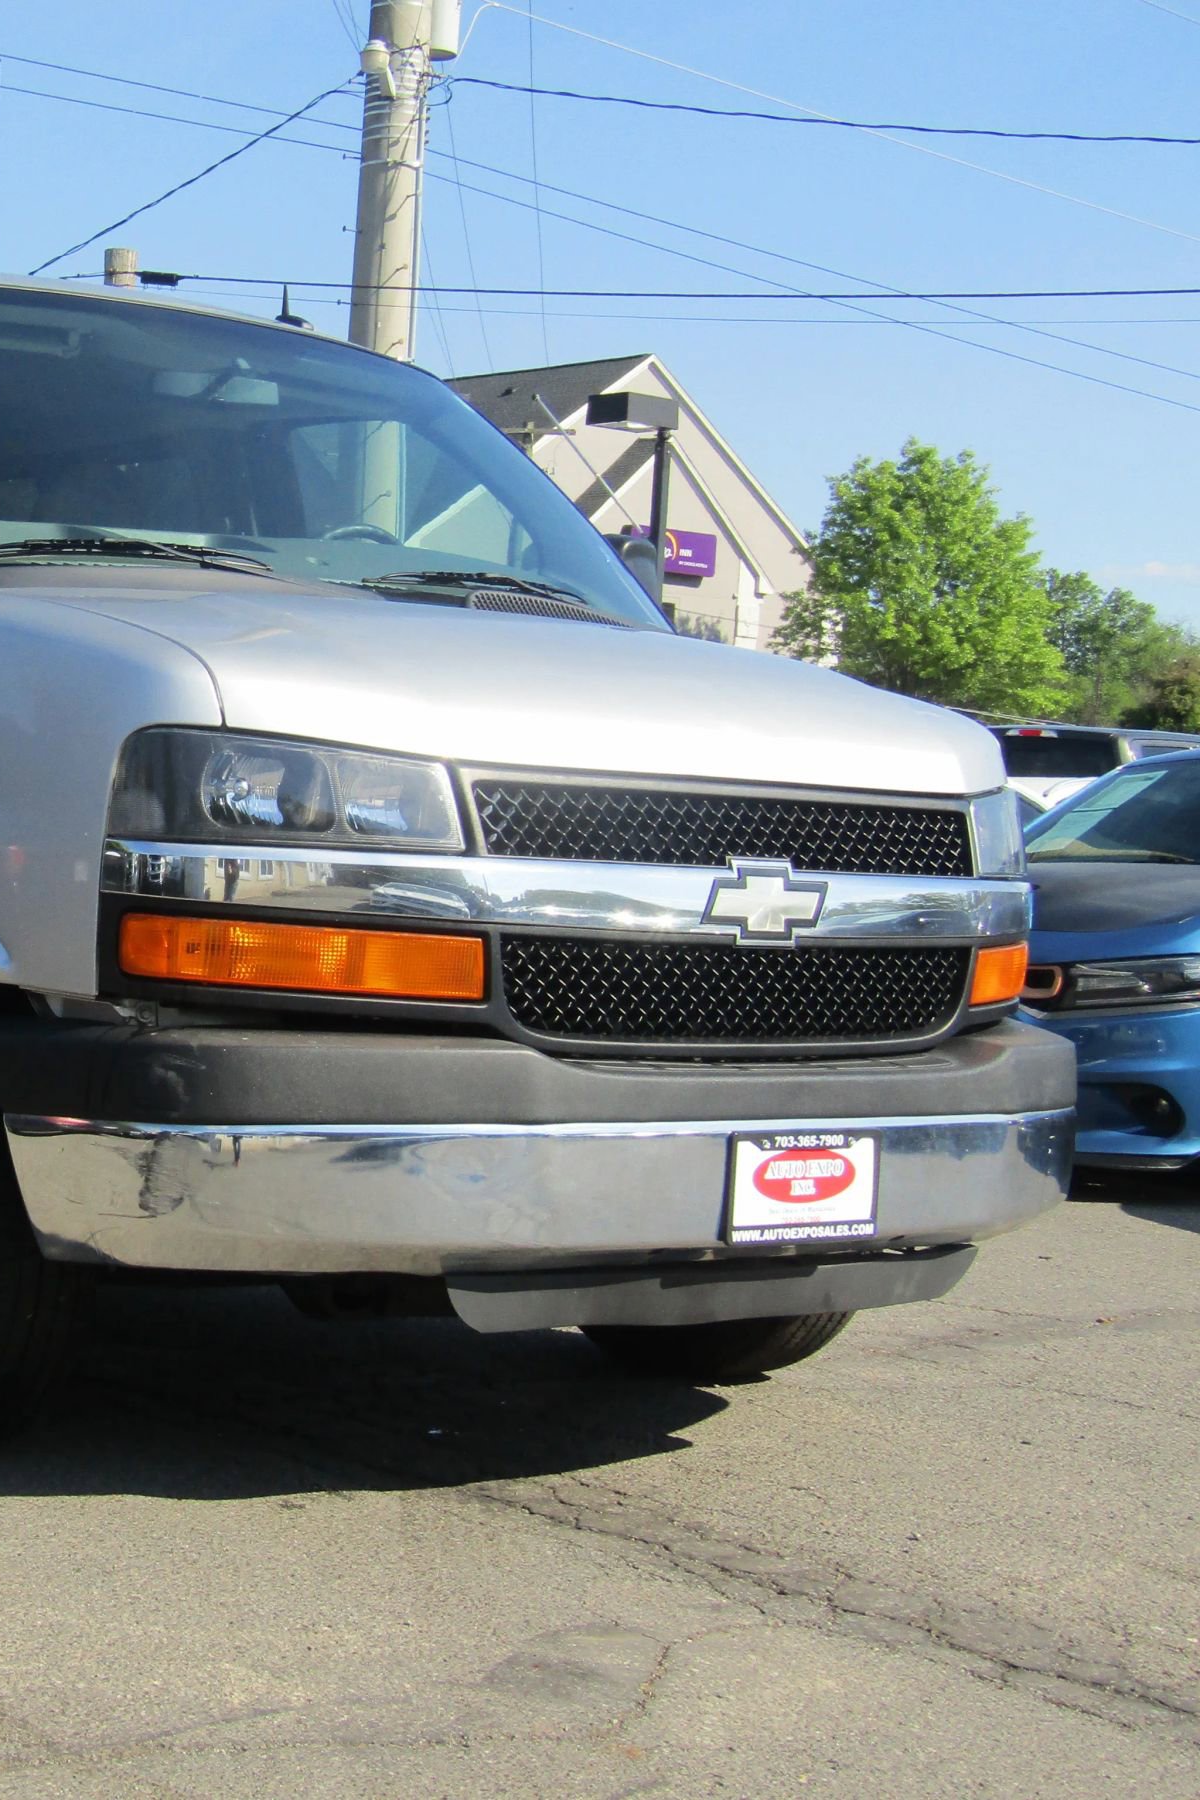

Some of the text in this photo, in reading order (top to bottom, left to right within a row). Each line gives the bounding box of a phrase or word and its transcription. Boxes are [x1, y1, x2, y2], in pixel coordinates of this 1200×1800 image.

[775, 1135, 844, 1148] 703-365-7900
[764, 1158, 845, 1179] AUTO EXPO
[732, 1224, 874, 1242] WWW.AUTOEXPOSALES.COM
